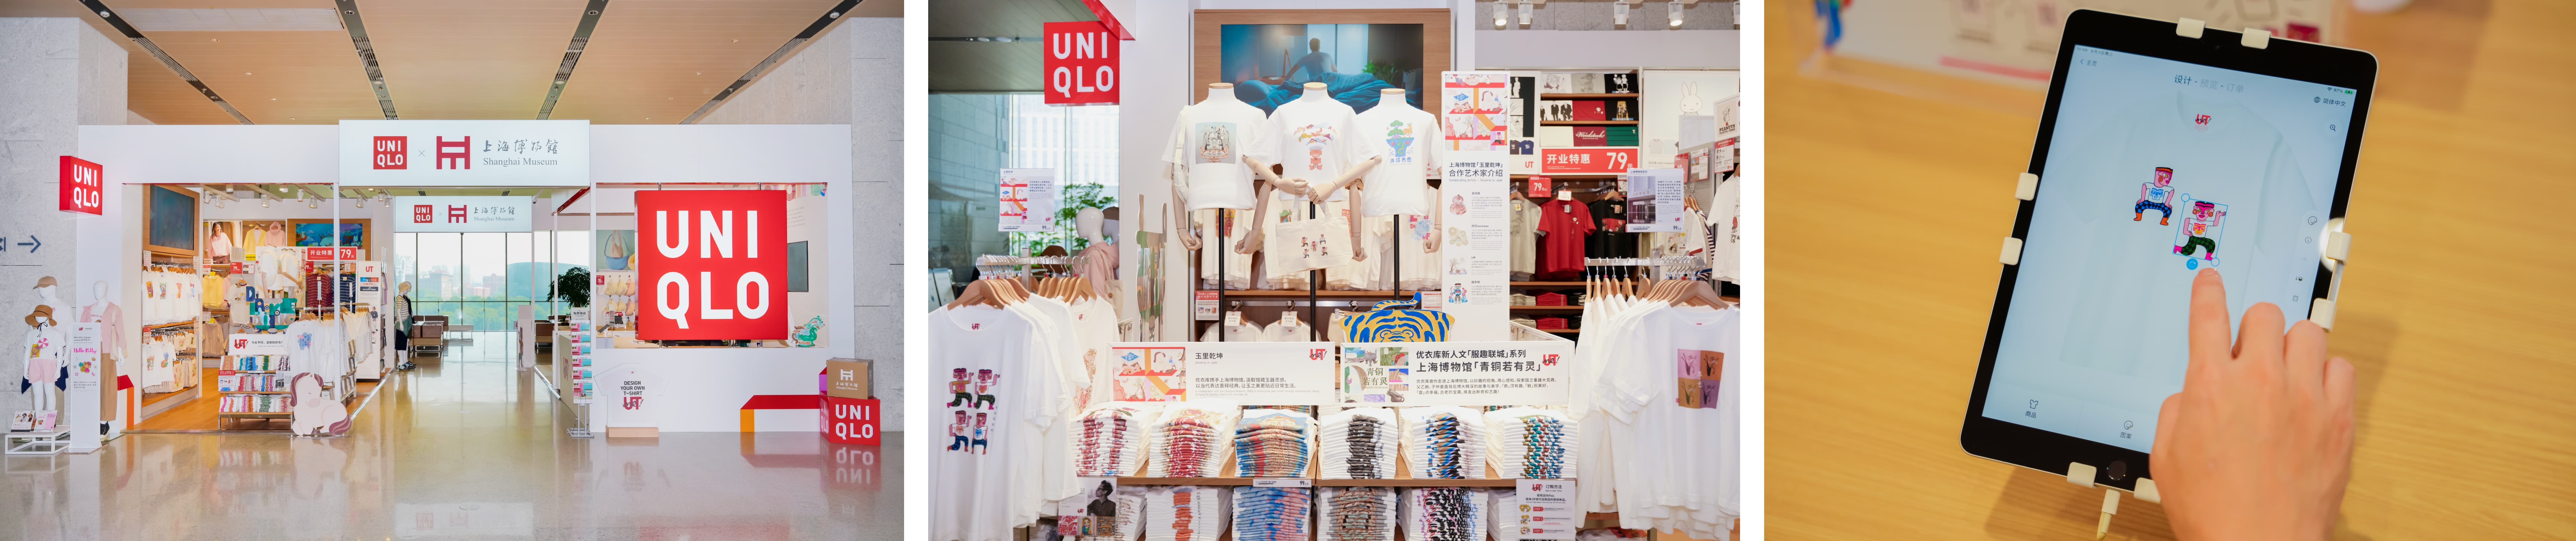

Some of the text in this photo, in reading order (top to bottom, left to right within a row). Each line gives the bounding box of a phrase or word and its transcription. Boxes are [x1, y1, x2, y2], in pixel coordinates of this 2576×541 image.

[1053, 32, 1107, 59] UNI
[1054, 65, 1114, 98] QLO
[2174, 75, 2244, 93] 设计 预览 订单
[2323, 98, 2346, 107] 简体中文
[377, 140, 401, 152] UNI
[377, 154, 403, 167] QLO
[483, 157, 558, 167] Shanghai Museum
[1547, 154, 1590, 164] 开业特惠
[74, 164, 97, 187] UNI
[1534, 183, 1542, 191] 79
[74, 187, 99, 208] QLO
[657, 211, 758, 258] UNI
[657, 271, 769, 329] QLO
[1416, 349, 1526, 359] 优衣库新人文「服趣联城」系列
[1367, 367, 1384, 376] 青铜
[1416, 361, 1541, 372] 上海博物馆「青铜若有灵」
[1362, 377, 1388, 386] 若有灵
[836, 404, 869, 420] UNI
[836, 422, 873, 440] QLO
